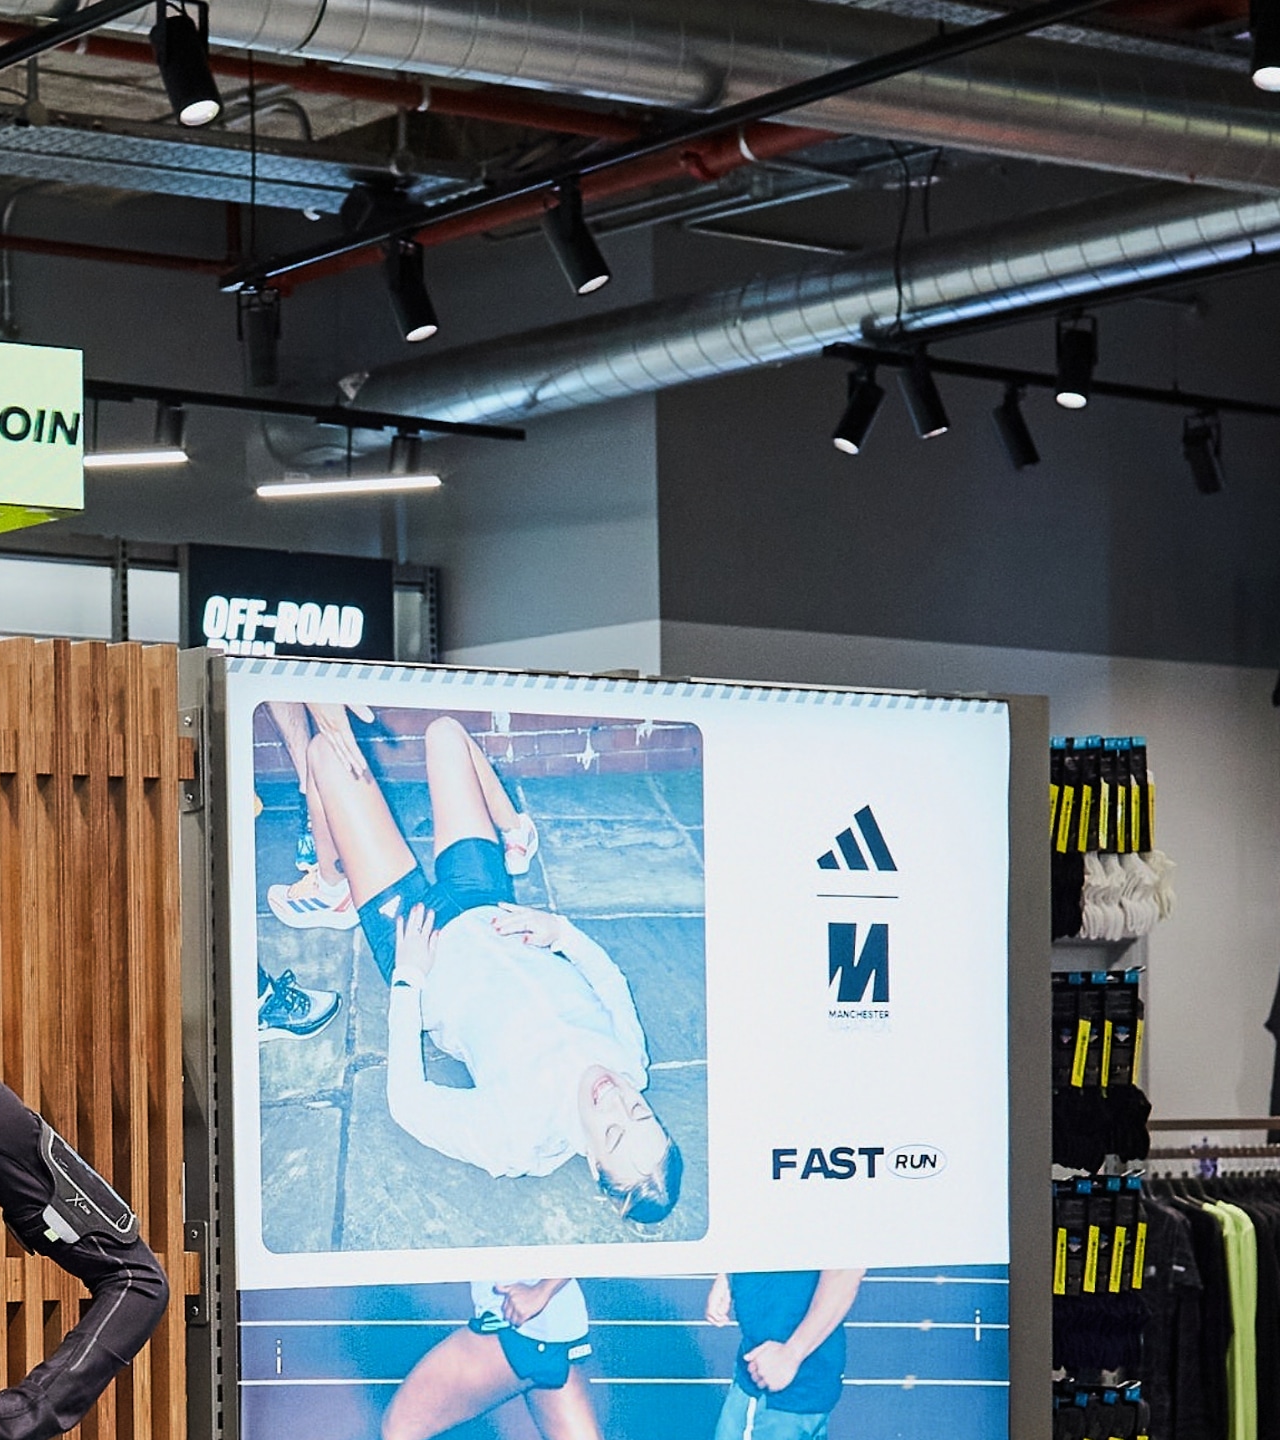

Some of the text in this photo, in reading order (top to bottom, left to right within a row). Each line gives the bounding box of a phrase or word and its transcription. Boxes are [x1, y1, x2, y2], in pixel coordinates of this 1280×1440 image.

[203, 595, 364, 648] OFF-ROAD
[828, 1010, 889, 1019] MANCHESTER
[771, 1146, 939, 1181] FAST RUN
